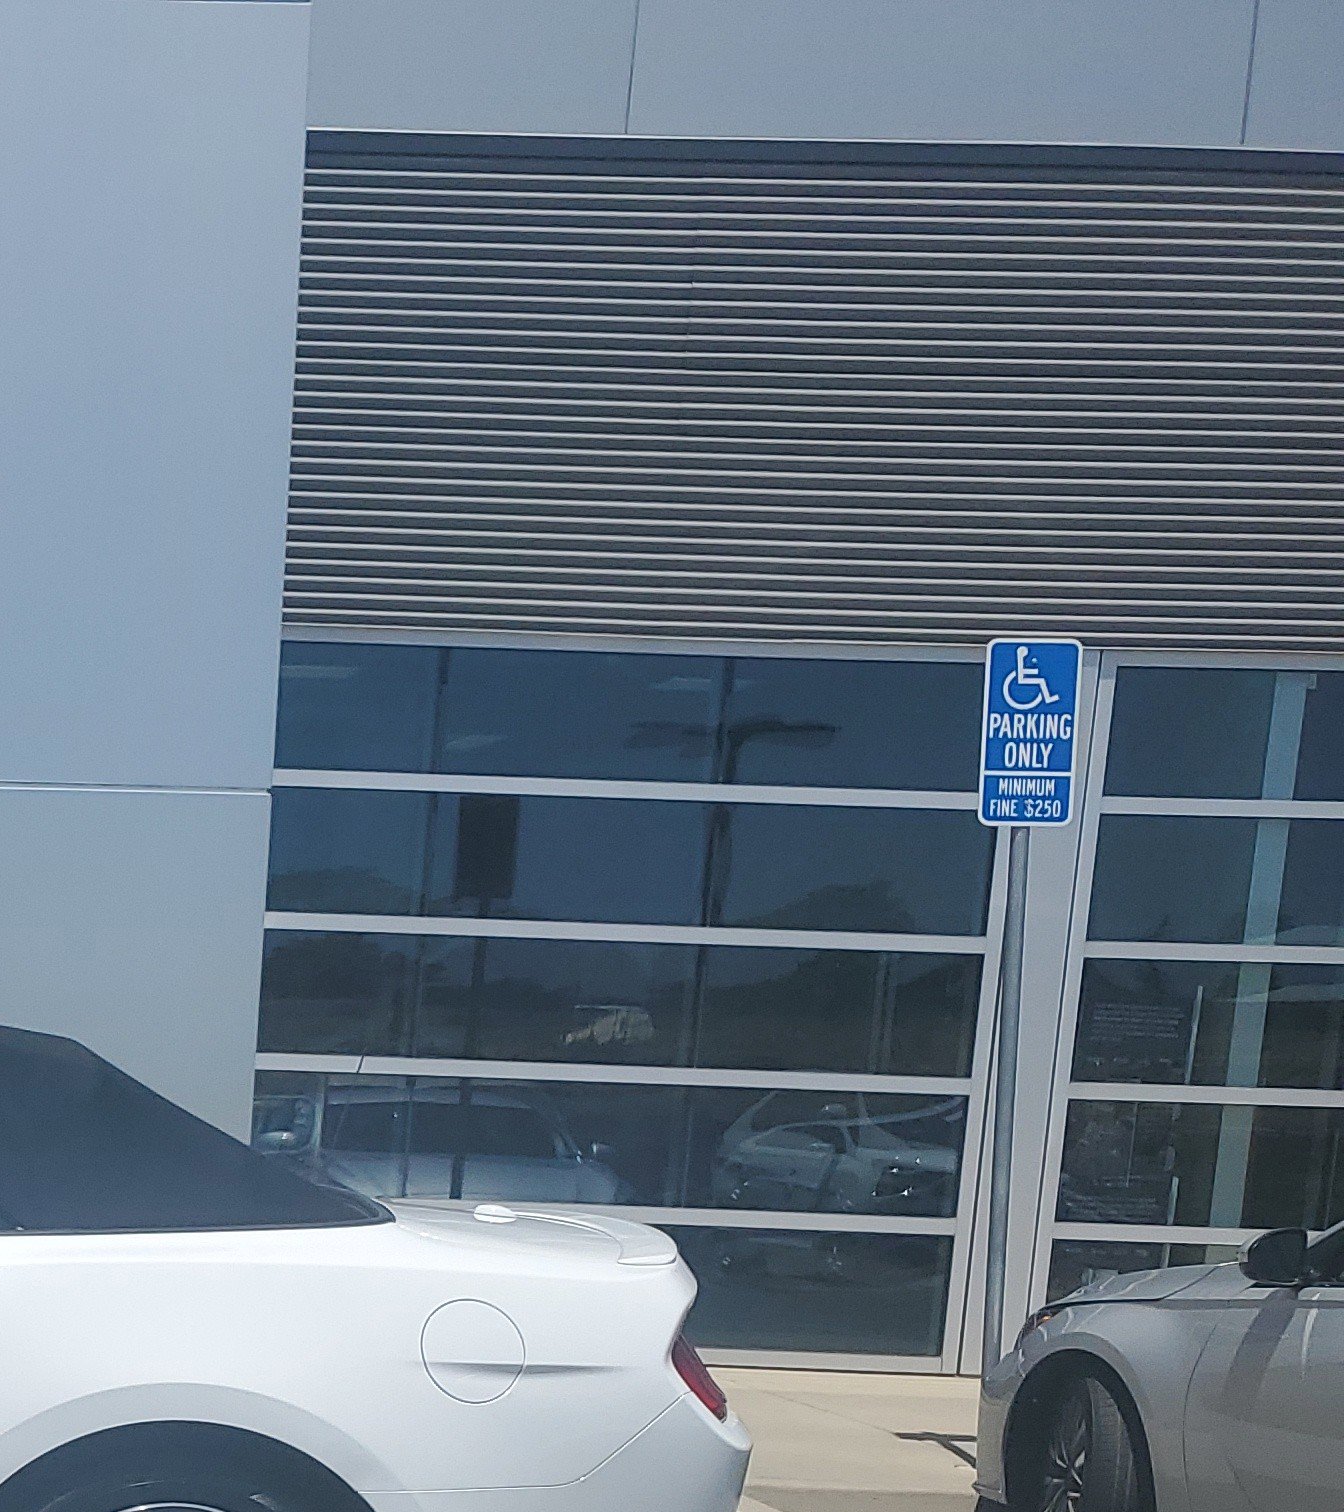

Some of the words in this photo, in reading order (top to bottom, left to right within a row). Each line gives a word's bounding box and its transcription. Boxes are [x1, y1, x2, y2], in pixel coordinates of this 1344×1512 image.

[988, 713, 1072, 740] PARKING
[1004, 741, 1054, 768] ONLY
[998, 778, 1056, 796] MINIMUM
[989, 799, 1018, 817] FINE
[1023, 799, 1062, 818] $250
